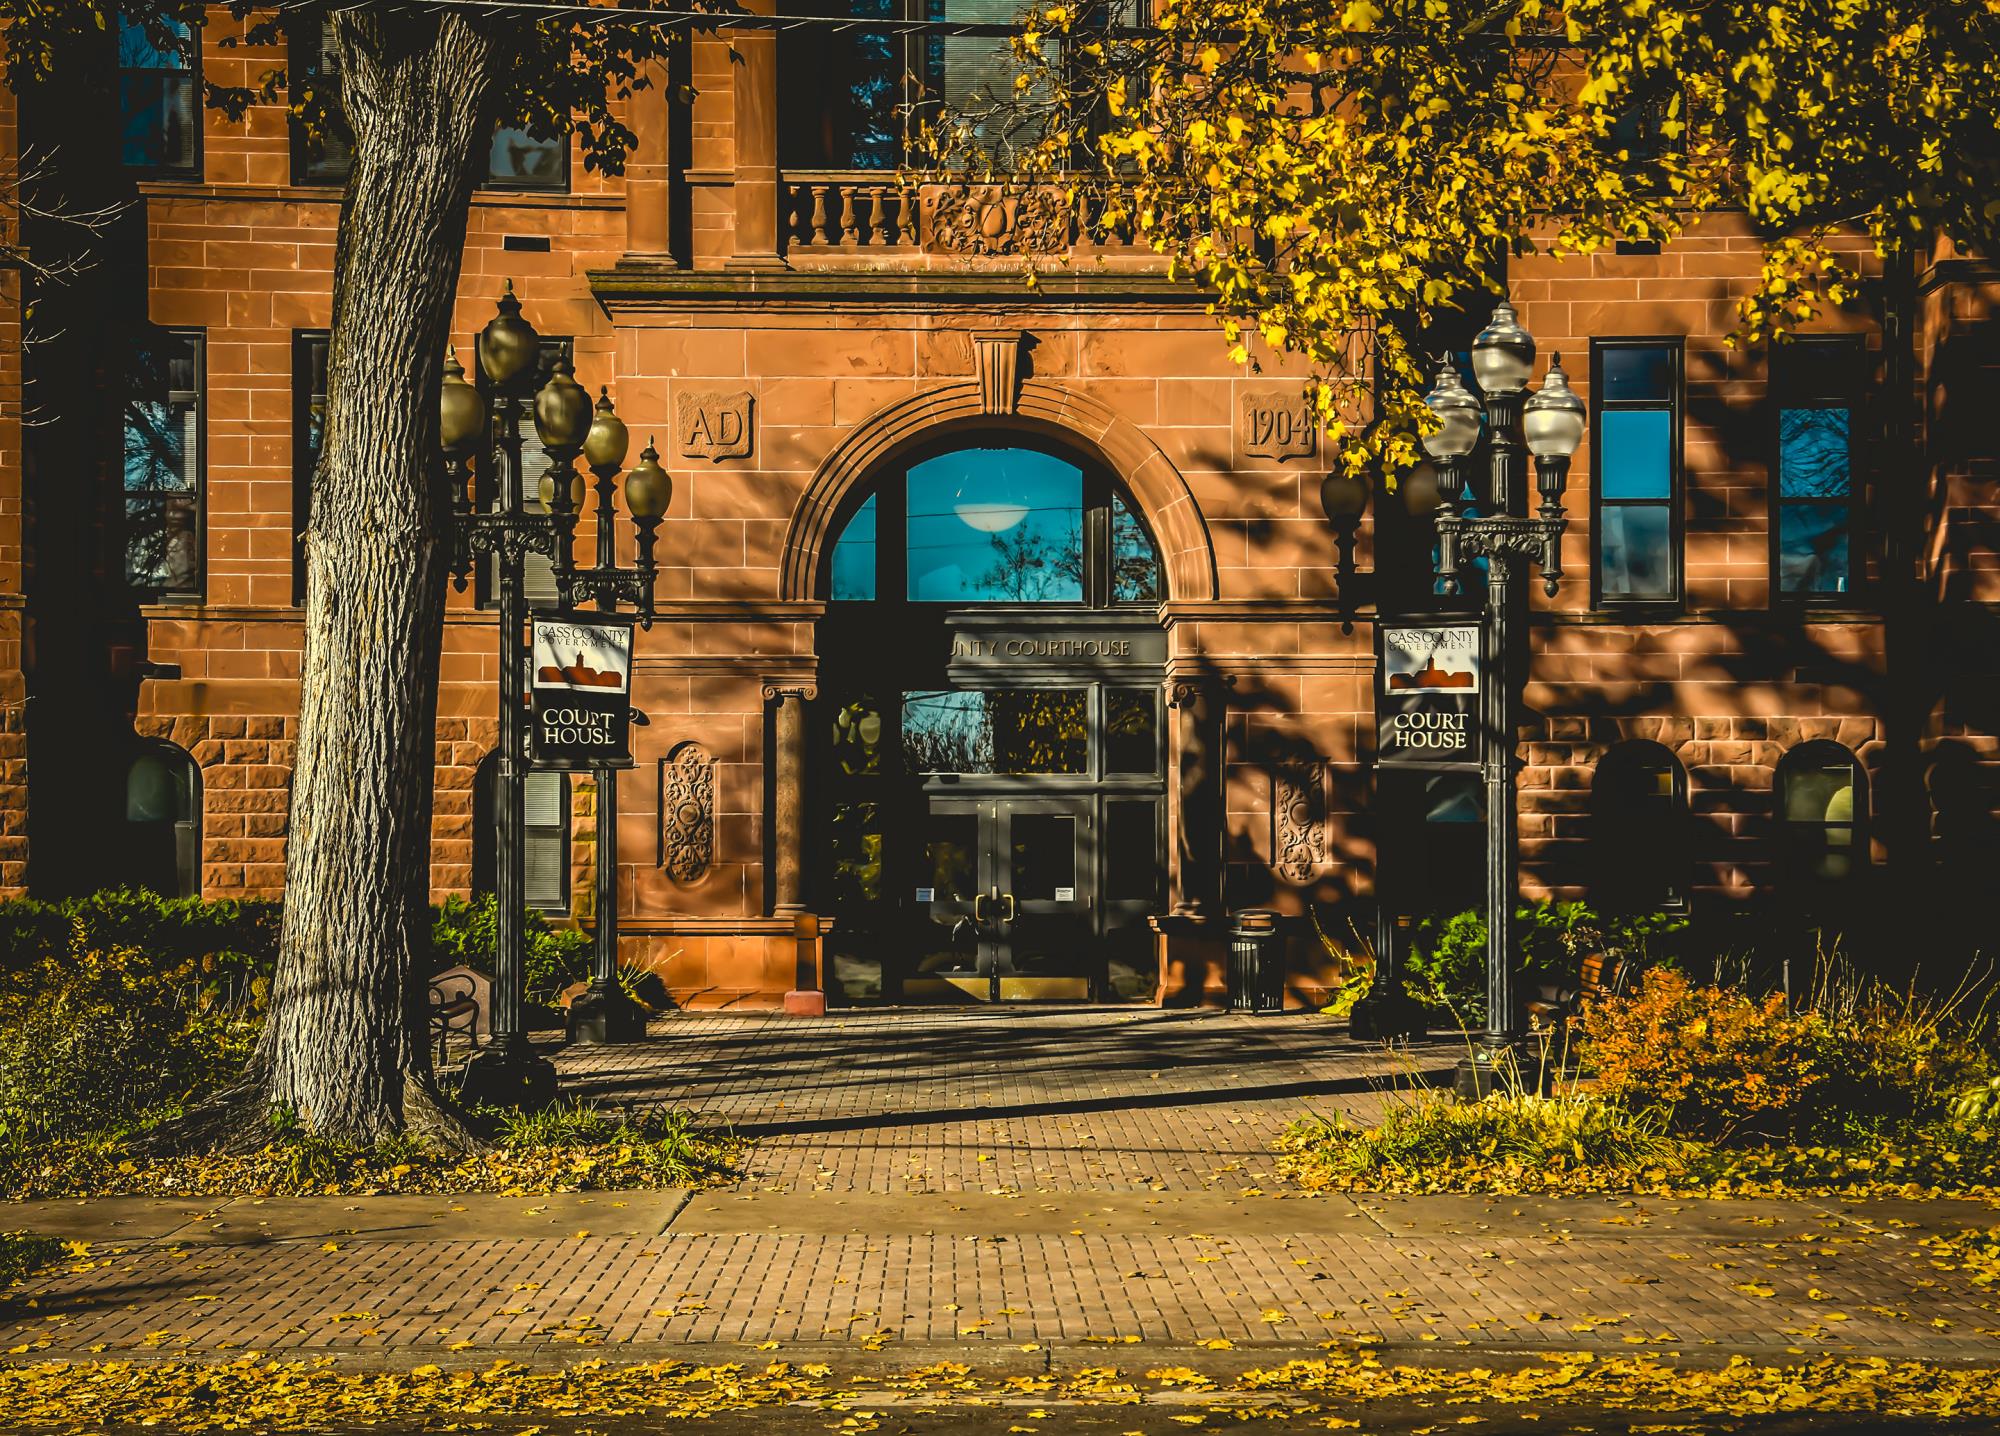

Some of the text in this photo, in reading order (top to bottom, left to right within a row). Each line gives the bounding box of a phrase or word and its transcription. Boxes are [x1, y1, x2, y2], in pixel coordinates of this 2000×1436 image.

[684, 407, 743, 446] AD
[1248, 408, 1311, 446] 1904
[537, 625, 626, 642] CASS COUNTY
[1387, 630, 1474, 644] CASS COUNTY
[538, 638, 624, 649] GOVERNMENT
[1005, 640, 1131, 657] COURTHOUSE
[1389, 641, 1474, 652] GOVERNMENT
[542, 709, 615, 729] COURT
[1394, 712, 1469, 730] COURT
[544, 727, 616, 745] HOUSE
[1394, 730, 1467, 749] HOUSE
